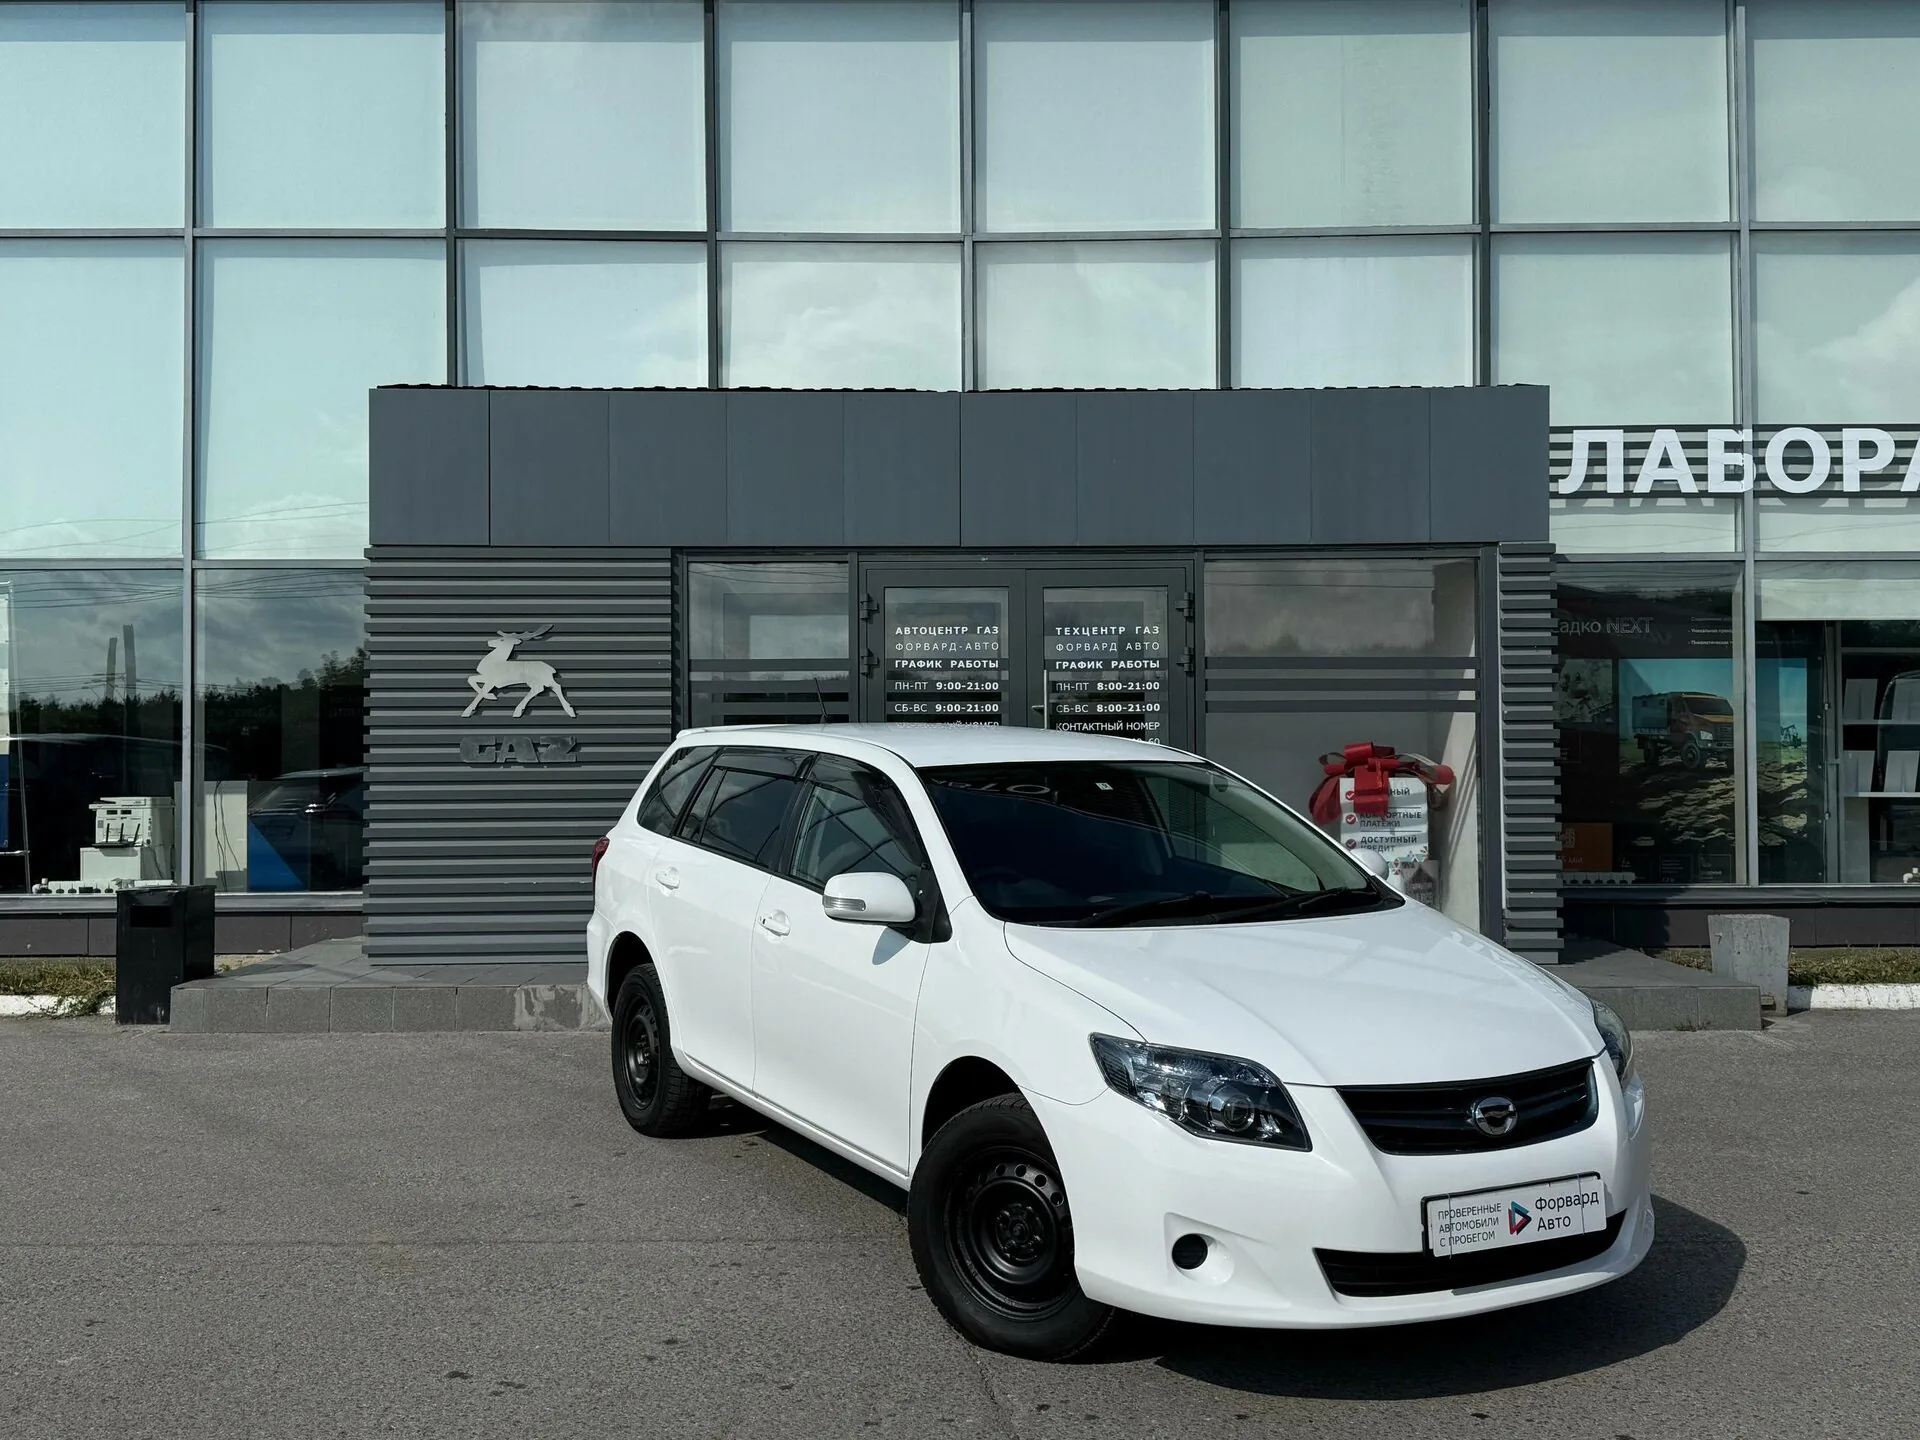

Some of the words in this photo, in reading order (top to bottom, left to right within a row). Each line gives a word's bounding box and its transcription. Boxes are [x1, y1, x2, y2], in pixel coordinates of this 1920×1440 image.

[895, 626, 969, 636] АВТОЦЕНТР
[977, 625, 999, 635] ГАЗ
[1056, 626, 1126, 636] ТЕХЦЕНТР
[1135, 625, 1160, 635] ГАЗ
[1606, 617, 1654, 634] NEXT
[895, 641, 1000, 652] ФОРВАРД-АВТО
[1056, 642, 1118, 652] ФОРВАРД
[1126, 641, 1160, 651] АВТО
[895, 659, 943, 669] ГРАФИК
[950, 659, 999, 669] РАБОТЫ
[1056, 660, 1103, 670] ГРАФИК
[1111, 660, 1160, 669] РАБОТЫ
[895, 681, 928, 691] ПН-ПТ
[935, 681, 999, 691] 9:00-21:00
[1056, 682, 1089, 691] ПН-ПТ
[1096, 681, 1160, 691] 8:00-21:00
[895, 703, 928, 713] СБ-ВС
[935, 703, 999, 713] 9:00-21:00
[1056, 704, 1089, 713] СБ-ВС
[1096, 703, 1160, 713] 8:00-21:00
[1056, 720, 1124, 731] КОНТАКТНЫЙ
[1126, 721, 1160, 731] НОМЕР
[1360, 811, 1422, 819] КОМОРТНЫЕ
[1360, 820, 1401, 828] ПЛАТЕЖИ
[1360, 835, 1418, 844] ДОСТУПНЫЙ
[1535, 1191, 1599, 1212] Форвард
[1438, 1202, 1502, 1220] ПРОВЕРЕННЫЕ
[1439, 1216, 1500, 1234] АВТОМОБИЛИ
[1537, 1215, 1571, 1232] Авто
[1439, 1237, 1446, 1247] С
[1449, 1231, 1496, 1247] ПРОБЕГОМ
